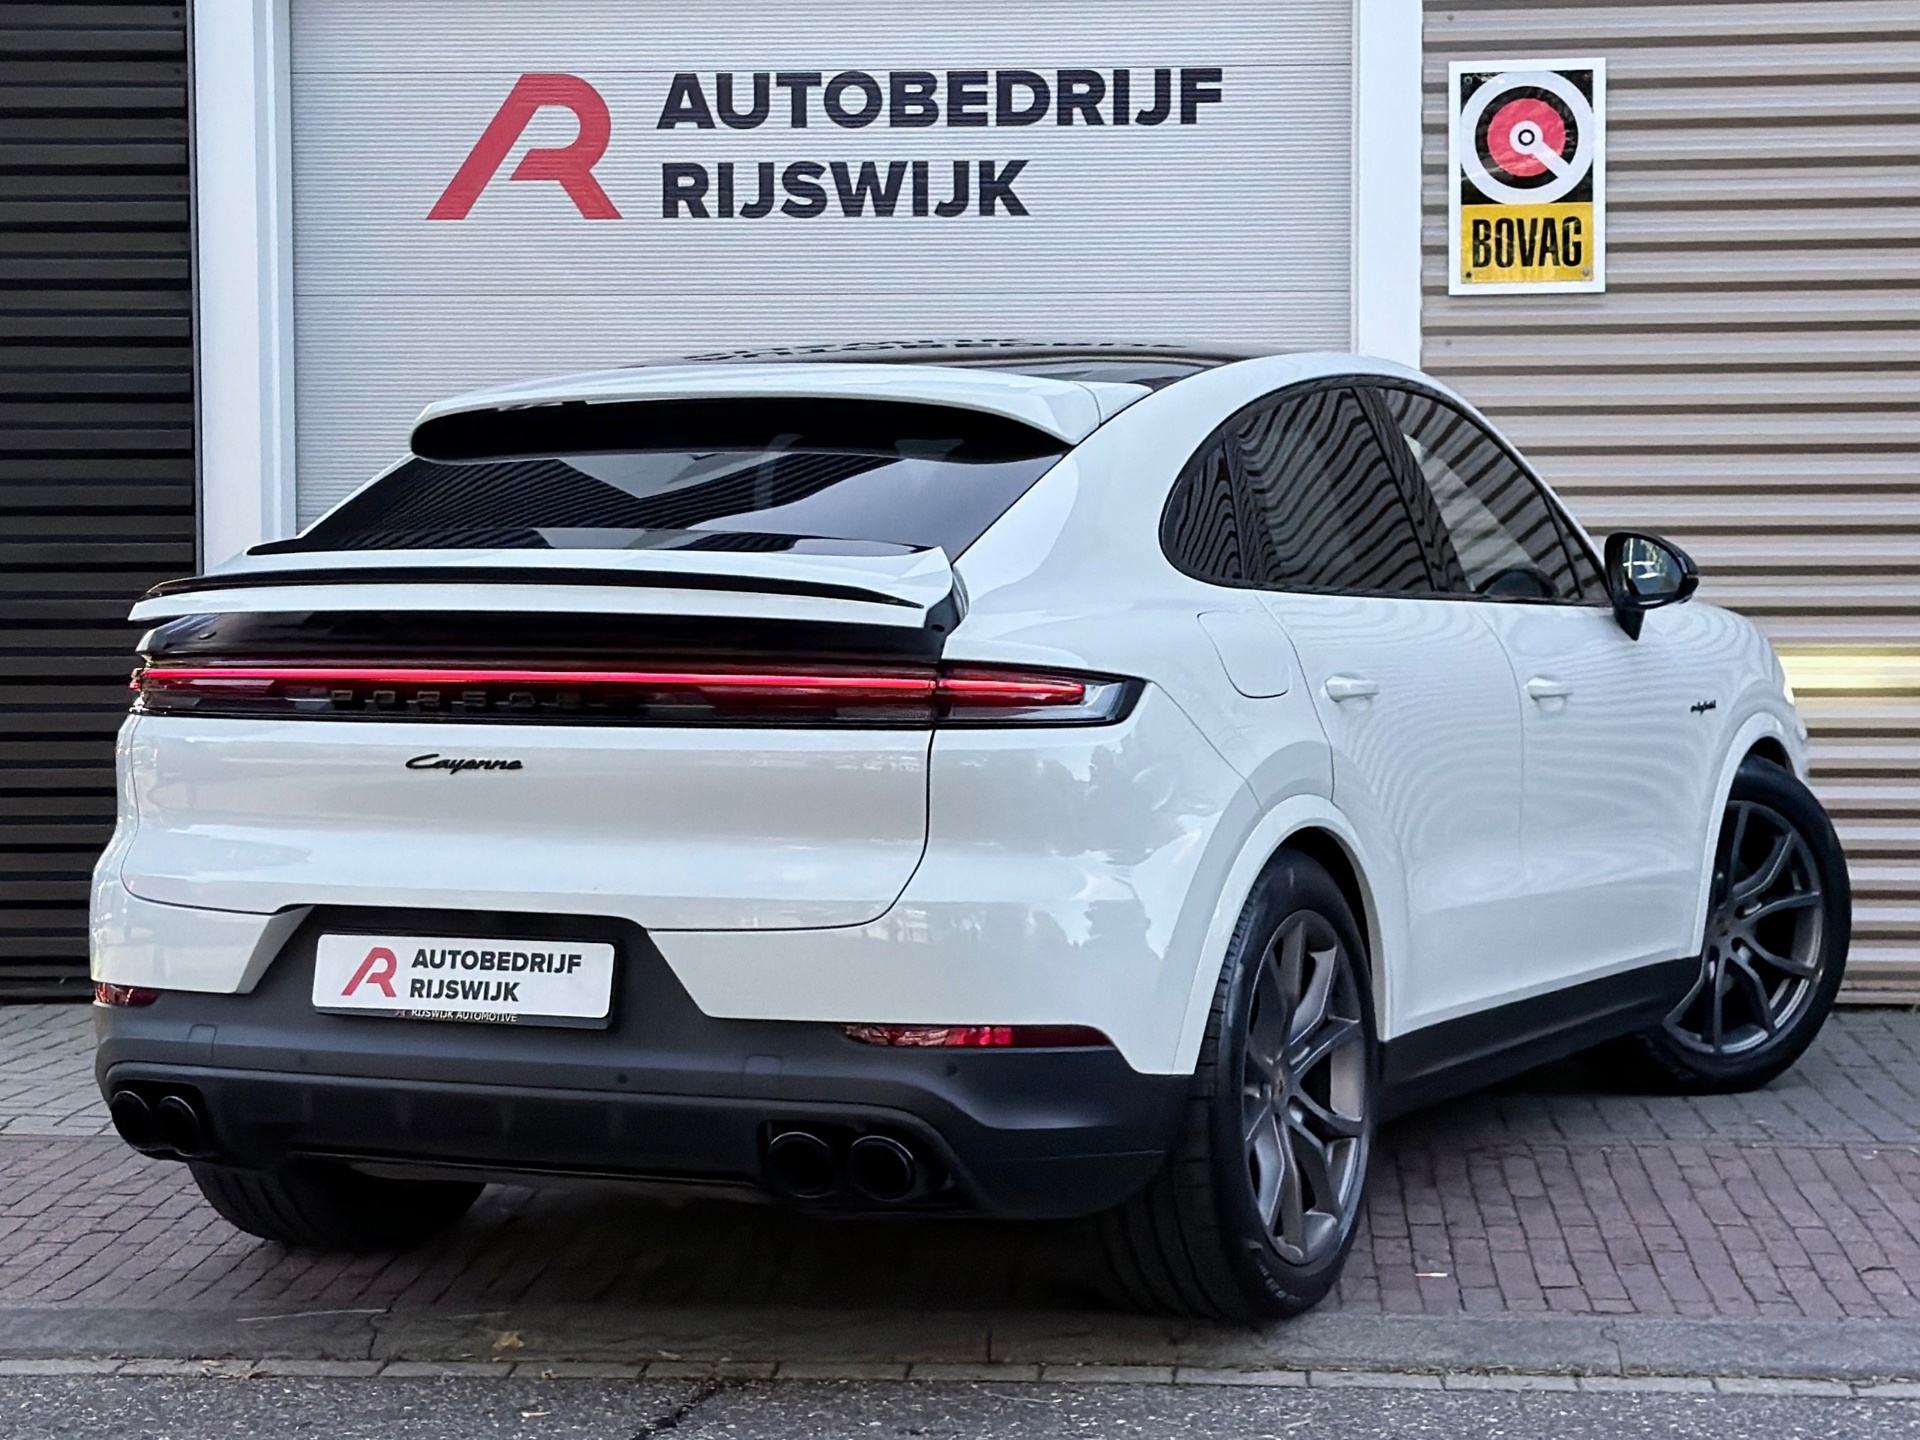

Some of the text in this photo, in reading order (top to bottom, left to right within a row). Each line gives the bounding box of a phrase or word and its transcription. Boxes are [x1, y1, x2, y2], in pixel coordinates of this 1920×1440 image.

[656, 67, 1223, 130] AUTOBEDRIJF
[661, 159, 1030, 219] RIJSWIJK
[1472, 215, 1582, 269] BOVAG
[405, 753, 524, 775] Cayenne
[411, 948, 583, 975] AUTOBEDRIJF
[409, 978, 520, 1003] RIJSWIJK
[411, 1008, 518, 1023] RIJSWIJK AUTOMOTIVE
